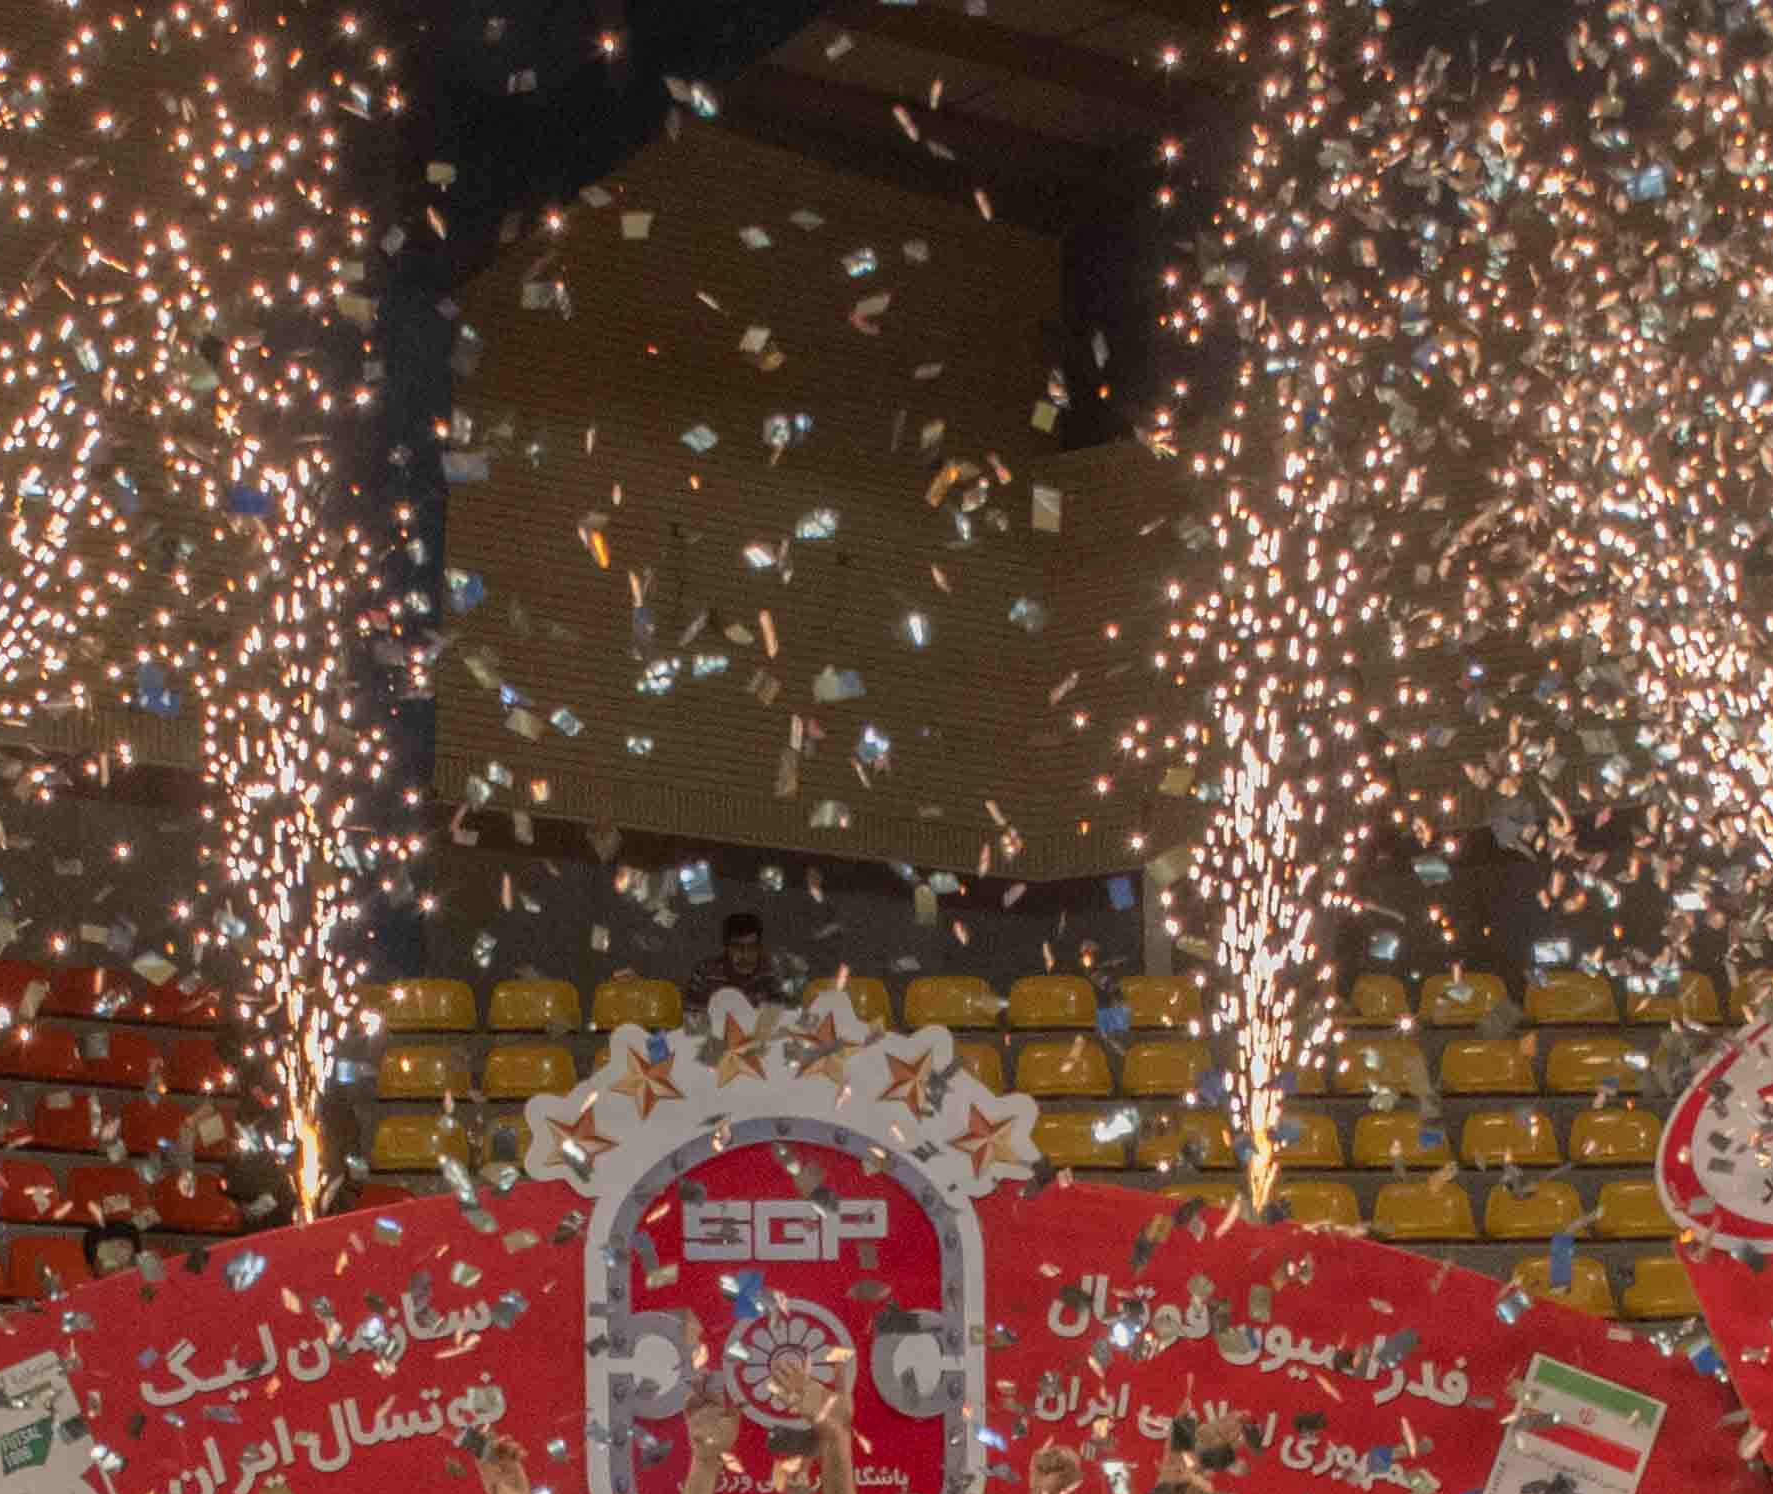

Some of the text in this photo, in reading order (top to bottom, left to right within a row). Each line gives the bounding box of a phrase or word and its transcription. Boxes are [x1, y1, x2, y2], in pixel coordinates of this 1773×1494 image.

[683, 1200, 888, 1262] SGP
[140, 1323, 280, 1407] لیگ
[306, 1372, 508, 1473] فوتسال
